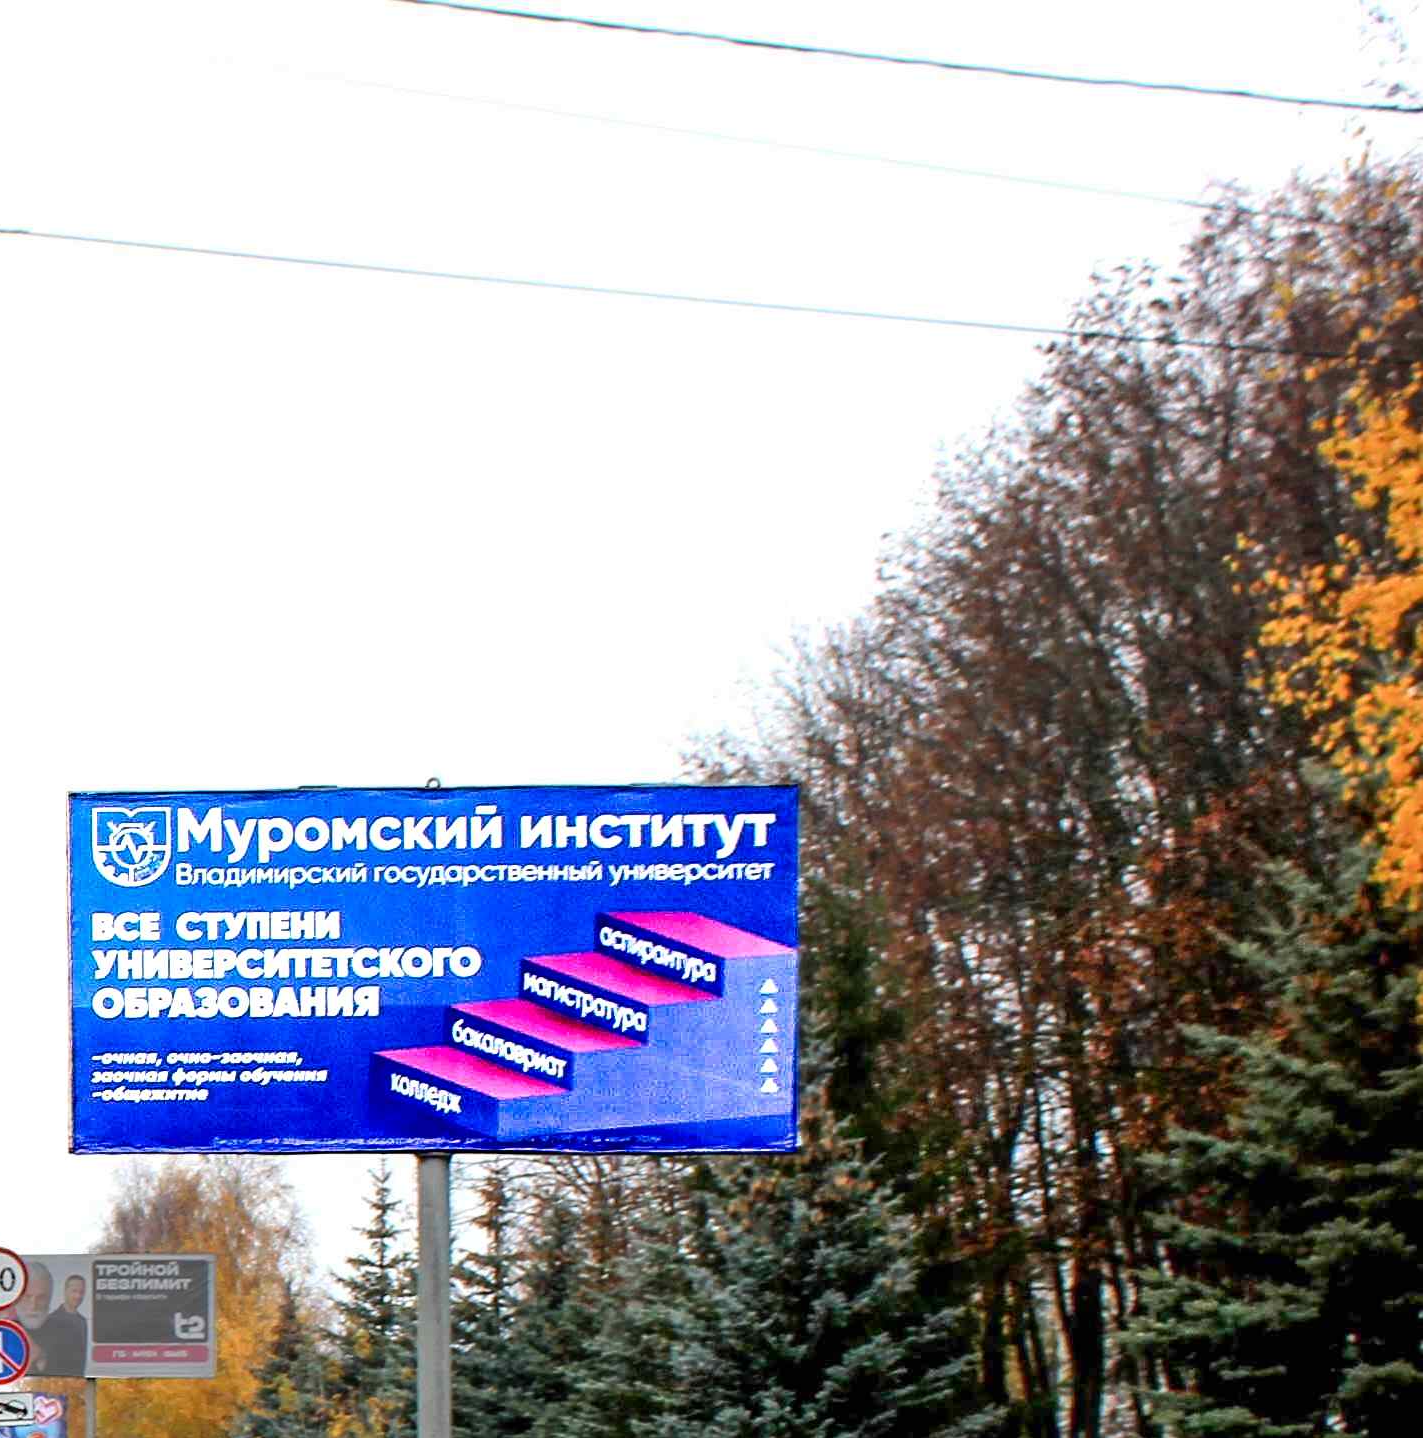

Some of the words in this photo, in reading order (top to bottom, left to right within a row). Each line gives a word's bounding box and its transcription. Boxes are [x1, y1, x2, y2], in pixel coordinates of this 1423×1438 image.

[177, 805, 502, 863] Муромский
[520, 812, 776, 859] институт
[176, 862, 368, 889] Владимирский
[374, 861, 602, 887] государственный
[608, 862, 775, 886] университет
[91, 912, 161, 942] ВСЕ
[176, 911, 341, 942] СТУПЕНИ
[91, 946, 483, 980] УНИВЕРСИТЕТСКОГО
[599, 926, 717, 983] аспирантура
[91, 985, 382, 1019] ОБРАЗОВАНИЯ
[523, 972, 647, 1032] магистратура
[451, 1018, 568, 1078] бакалавриат
[91, 1070, 169, 1083] заочная
[171, 1067, 237, 1086] формы
[239, 1067, 329, 1085] обучения
[390, 1073, 462, 1114] колледж
[95, 1261, 180, 1276] ТРОЙНОЙ
[96, 1278, 192, 1290] БЕЗЛИМИТ
